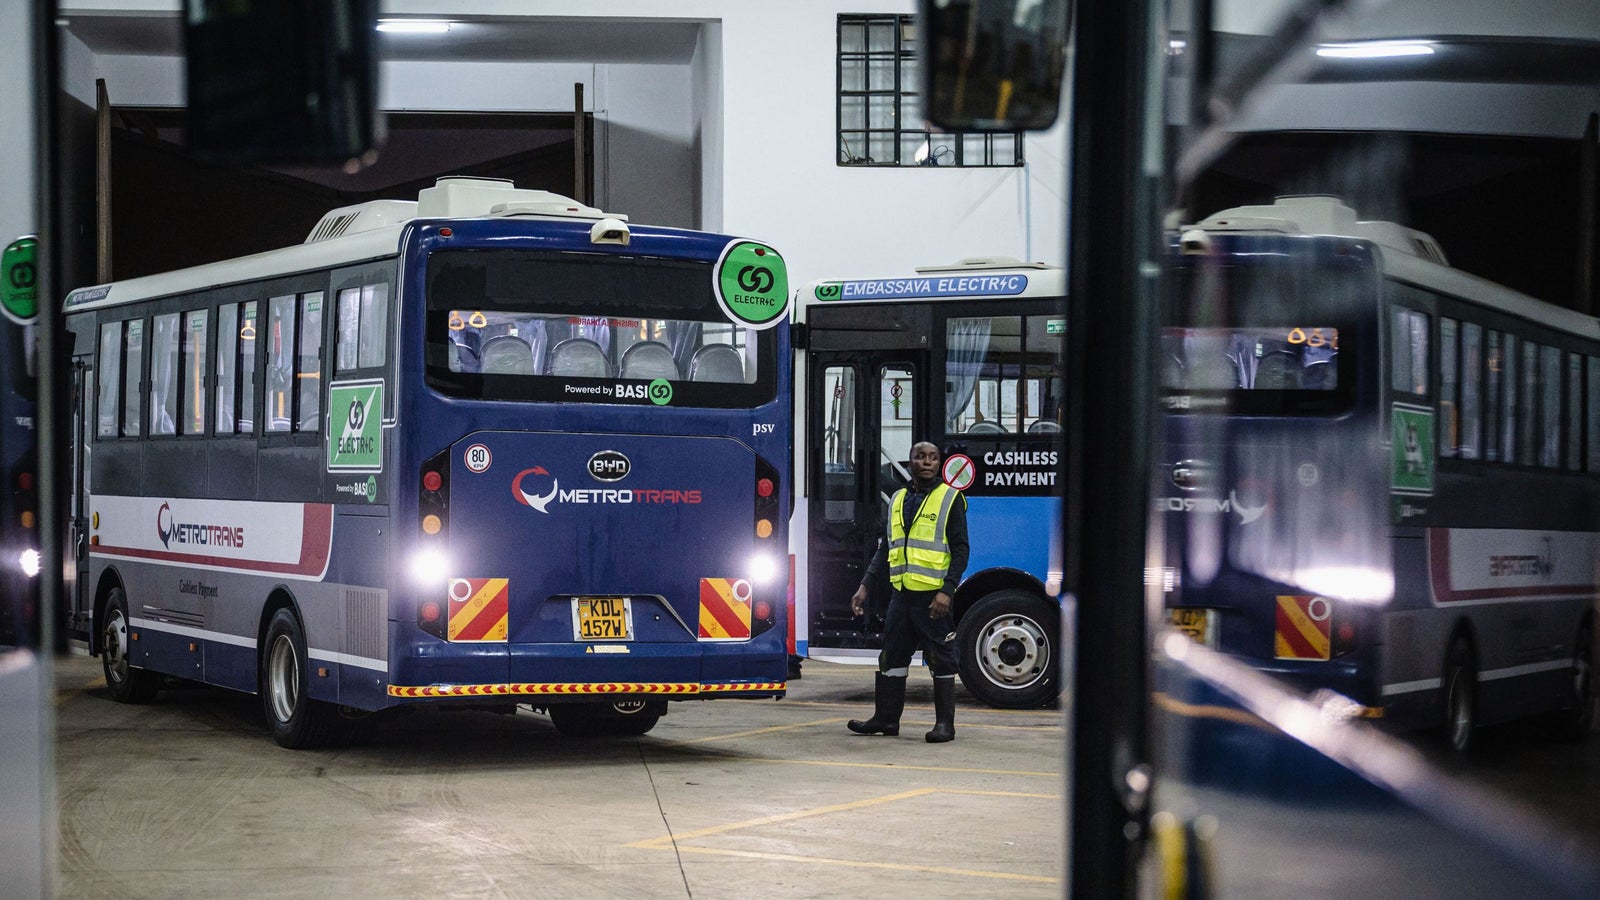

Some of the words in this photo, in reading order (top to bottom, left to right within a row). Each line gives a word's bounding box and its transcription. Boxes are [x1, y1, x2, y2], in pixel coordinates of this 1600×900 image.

[843, 280, 931, 296] EMBASSAVA
[564, 384, 601, 394] Powered
[602, 385, 614, 396] by
[752, 423, 775, 436] psv
[471, 449, 485, 463] 80
[983, 451, 1058, 466] CASHLESS
[593, 459, 626, 473] BYD
[985, 472, 1057, 486] PAYMENT
[559, 489, 702, 504] METROTRANS
[172, 523, 244, 548] METROTRANS
[179, 579, 198, 595] Cashless
[198, 581, 218, 599] Payment
[590, 600, 621, 617] KDL
[583, 620, 621, 637] 157W
